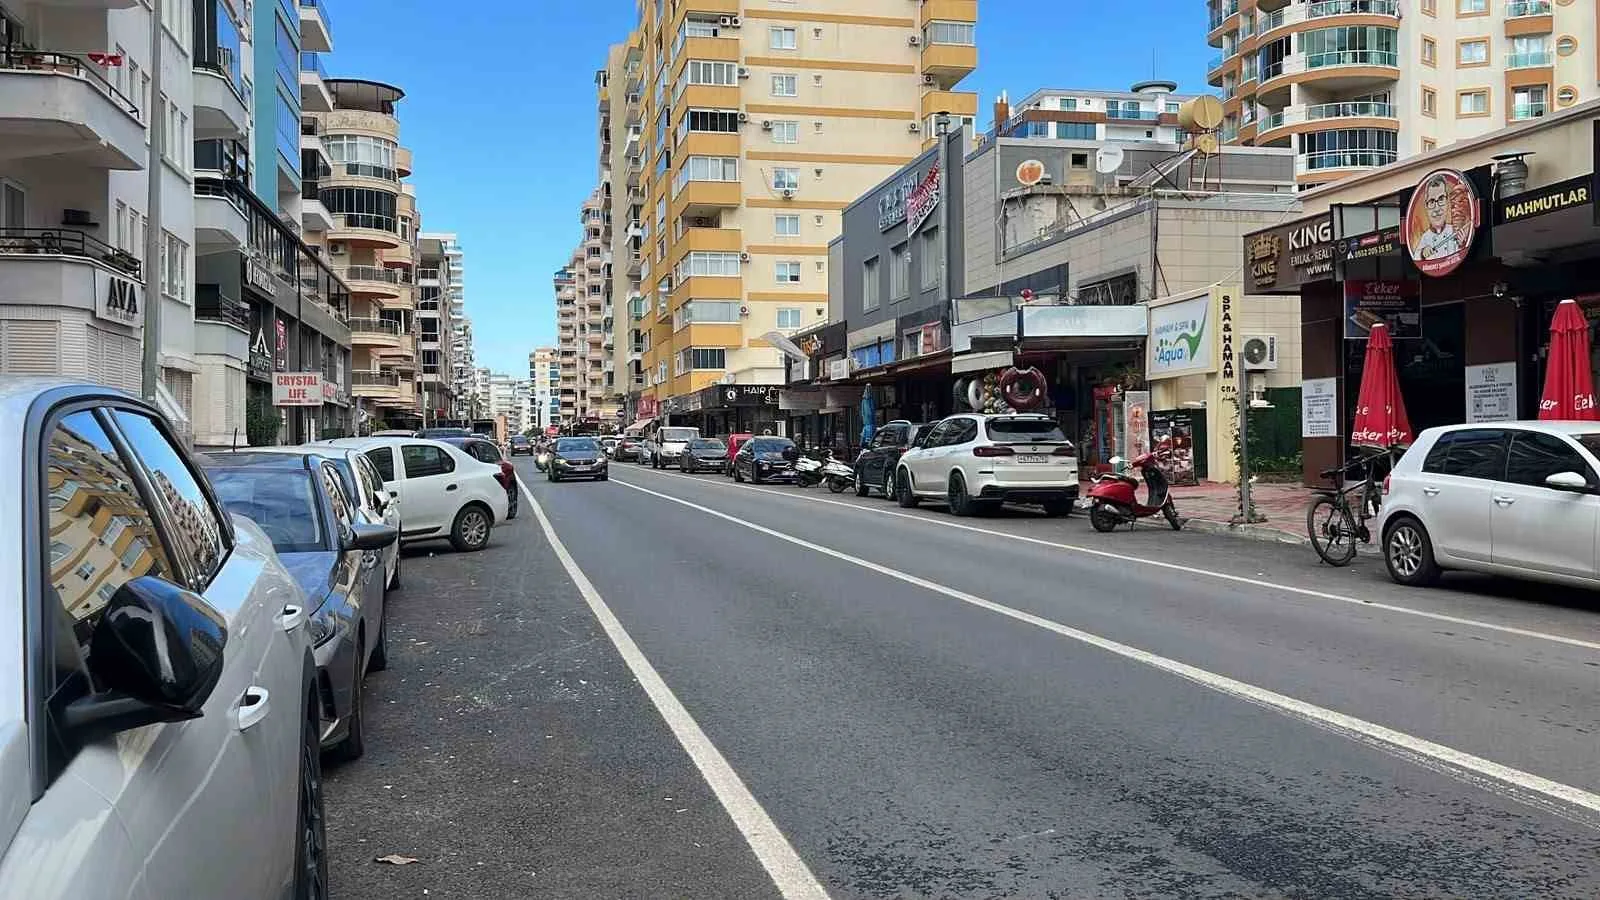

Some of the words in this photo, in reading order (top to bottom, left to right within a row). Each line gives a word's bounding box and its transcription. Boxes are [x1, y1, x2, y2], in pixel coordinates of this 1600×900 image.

[1505, 187, 1587, 219] MAHMUTLAR
[1288, 221, 1331, 251] KING
[1252, 260, 1276, 278] KING
[1306, 263, 1333, 275] www.
[106, 276, 138, 314] AVA
[1222, 295, 1231, 321] SPA
[1223, 324, 1232, 333] &
[1158, 347, 1184, 367] Aqua
[1223, 335, 1233, 379] HAMAM
[276, 375, 319, 386] CRYSTAL
[288, 388, 307, 399] LIFE
[743, 386, 766, 395] HAIR
